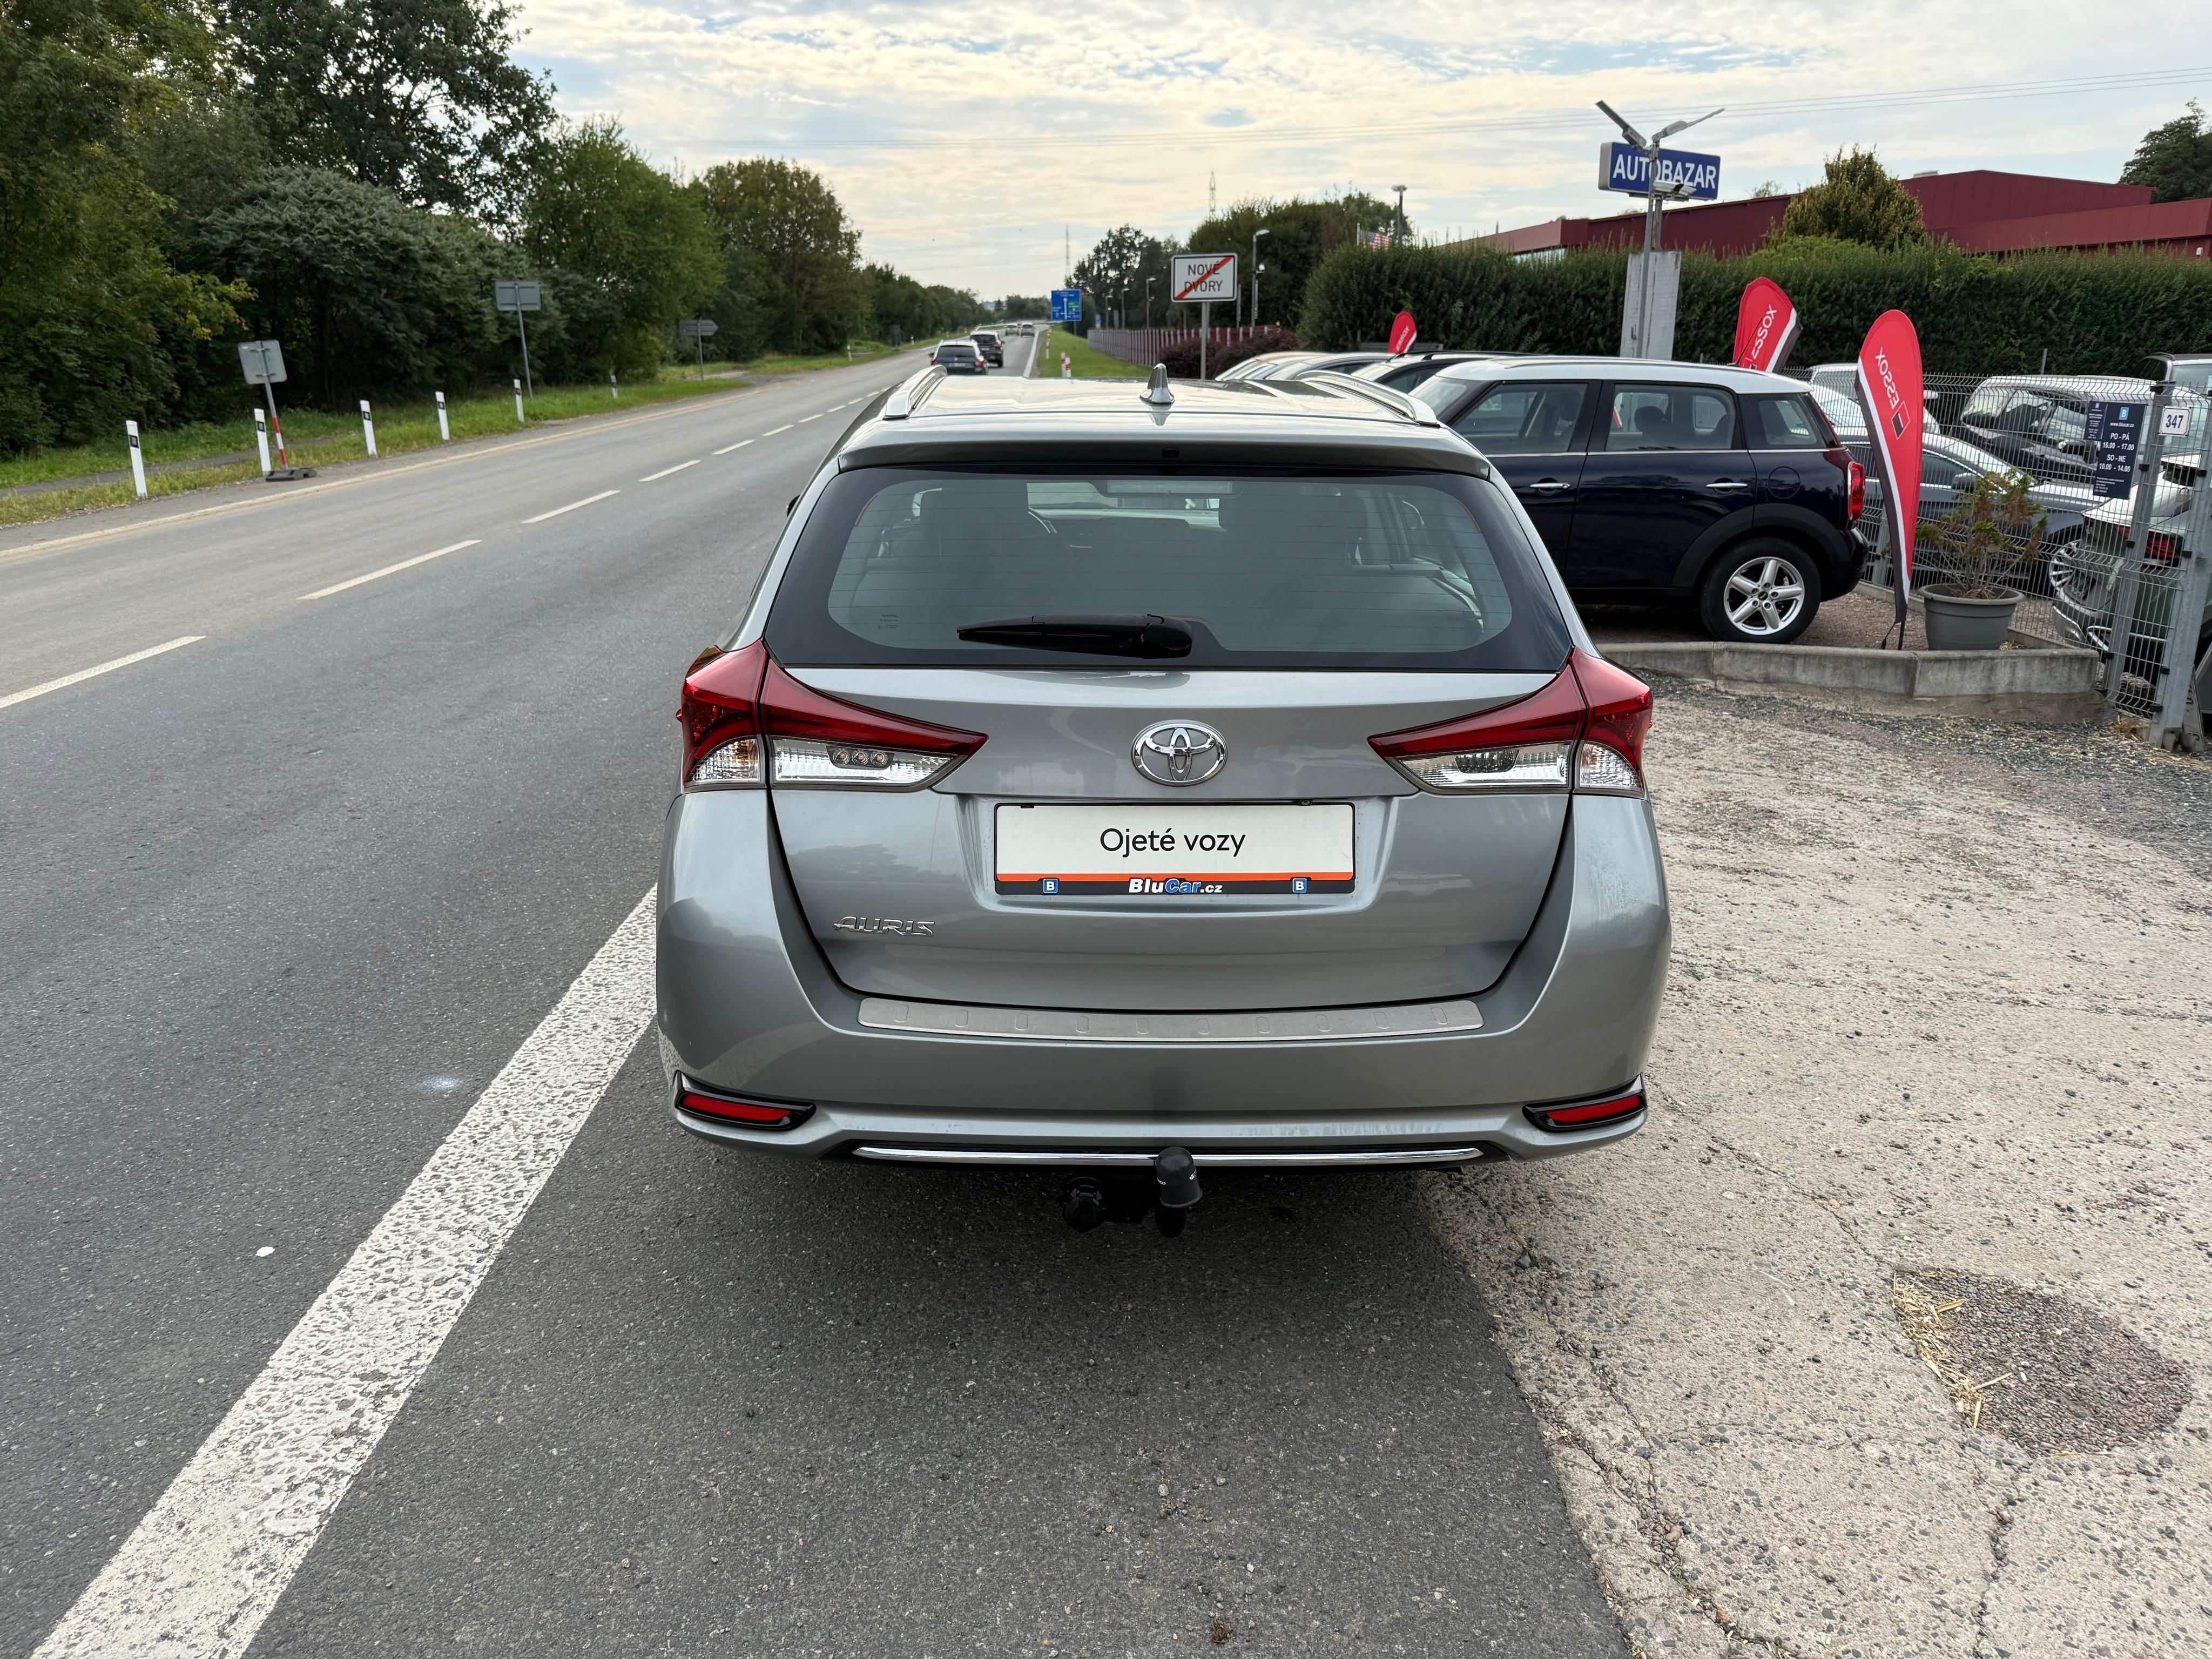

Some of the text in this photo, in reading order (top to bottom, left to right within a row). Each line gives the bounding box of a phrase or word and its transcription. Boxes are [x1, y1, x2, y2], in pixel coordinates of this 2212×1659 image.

[1613, 154, 1716, 189] AUTOBAZAR
[1188, 261, 1220, 276] NOVÉ
[1184, 280, 1223, 292] DVORY
[1751, 304, 1777, 360] ESSOX
[2166, 414, 2184, 428] 347
[1100, 828, 1246, 858] Ojeté vozy
[1047, 881, 1055, 891] B
[1129, 878, 1223, 893] BluCar.cz
[1296, 881, 1304, 891] B
[833, 916, 935, 936] AURIS
